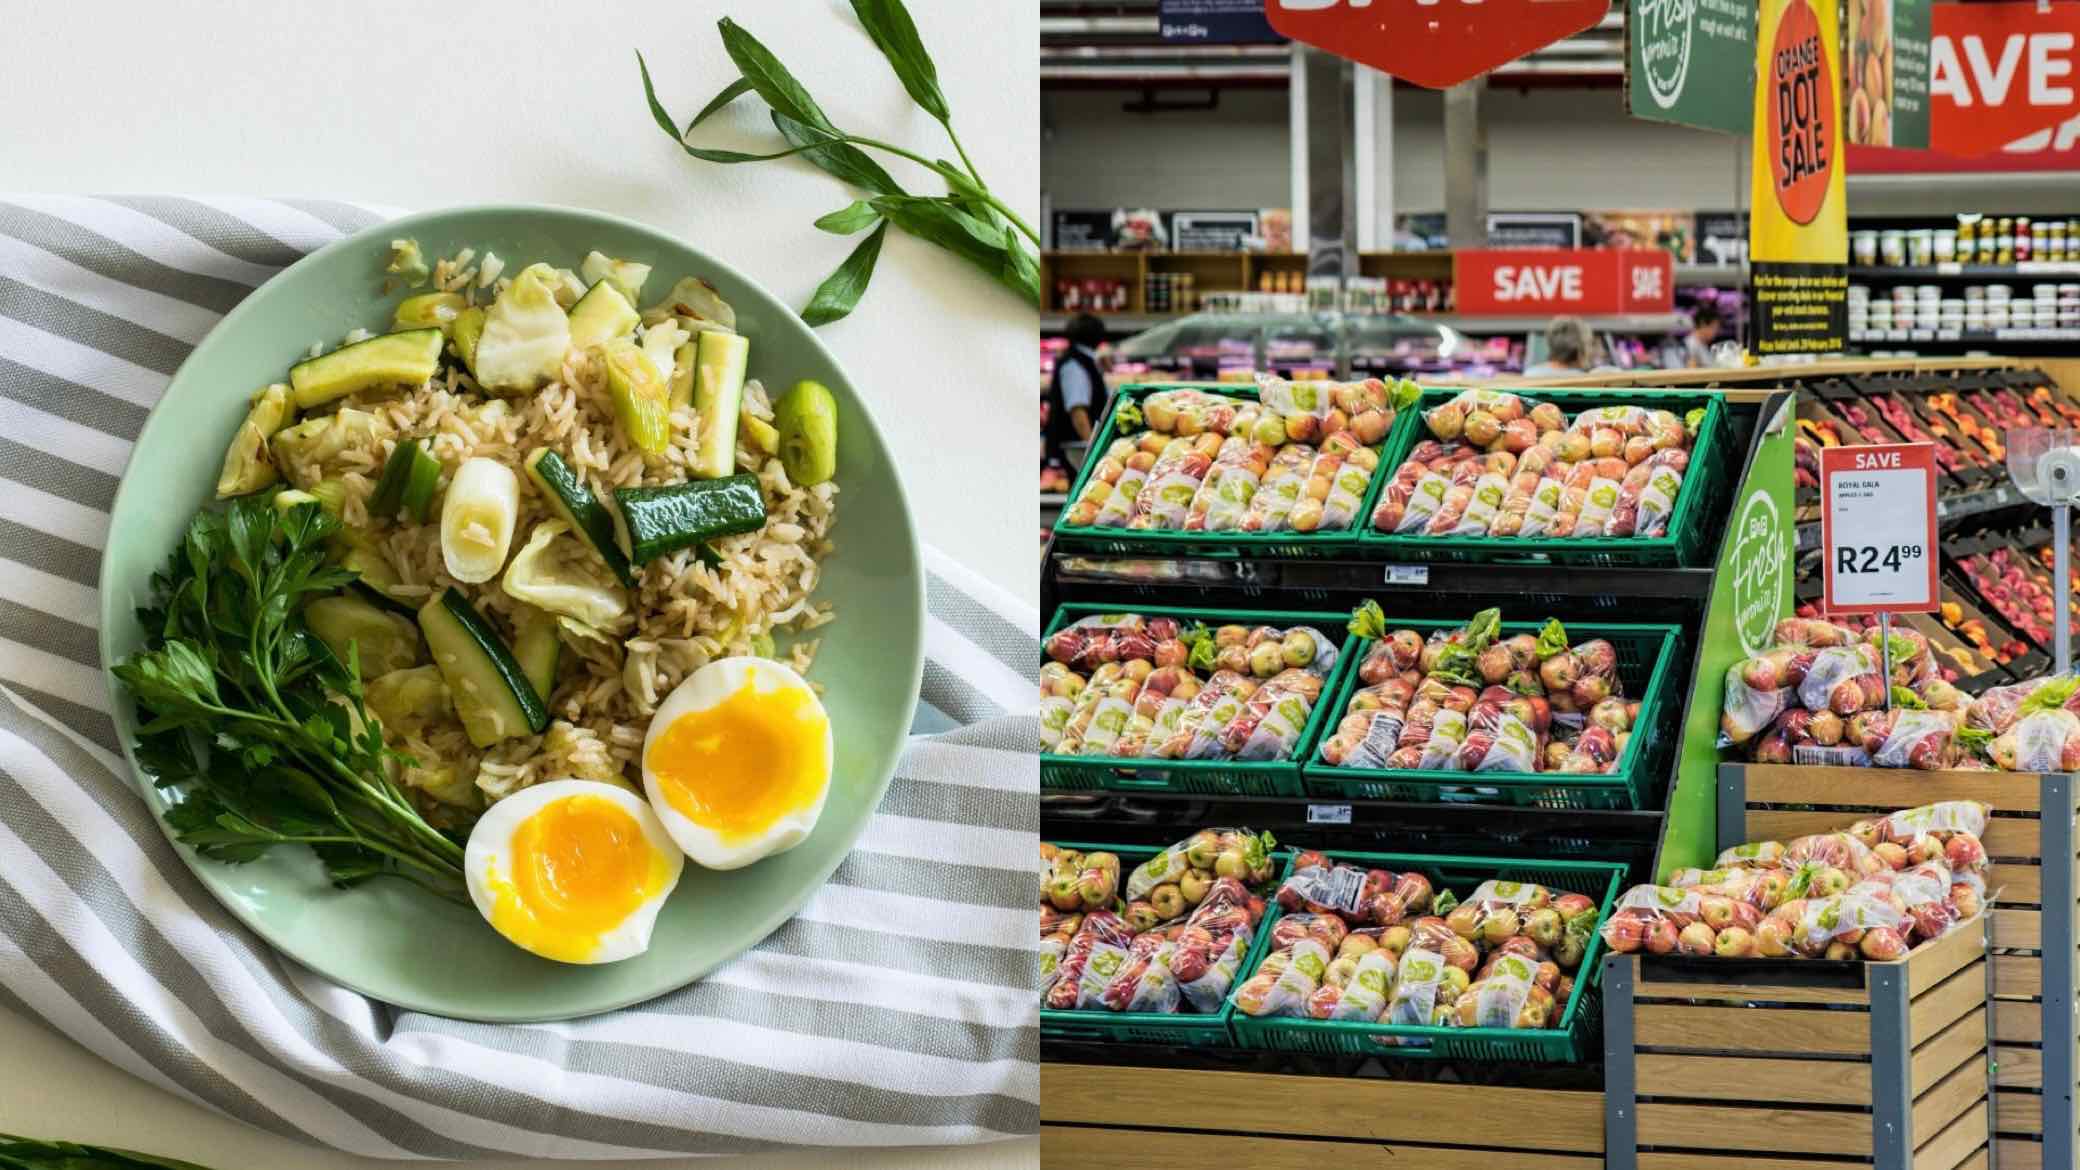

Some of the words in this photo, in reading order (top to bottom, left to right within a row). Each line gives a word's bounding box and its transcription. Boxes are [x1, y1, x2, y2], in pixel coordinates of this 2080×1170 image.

[1776, 36, 1819, 80] ORANGE
[1778, 67, 1819, 136] DOT
[1780, 122, 1827, 189] SALE
[1493, 264, 1584, 301] SAVE
[1855, 452, 1901, 469] SAVE
[1730, 529, 1788, 601] Fresh
